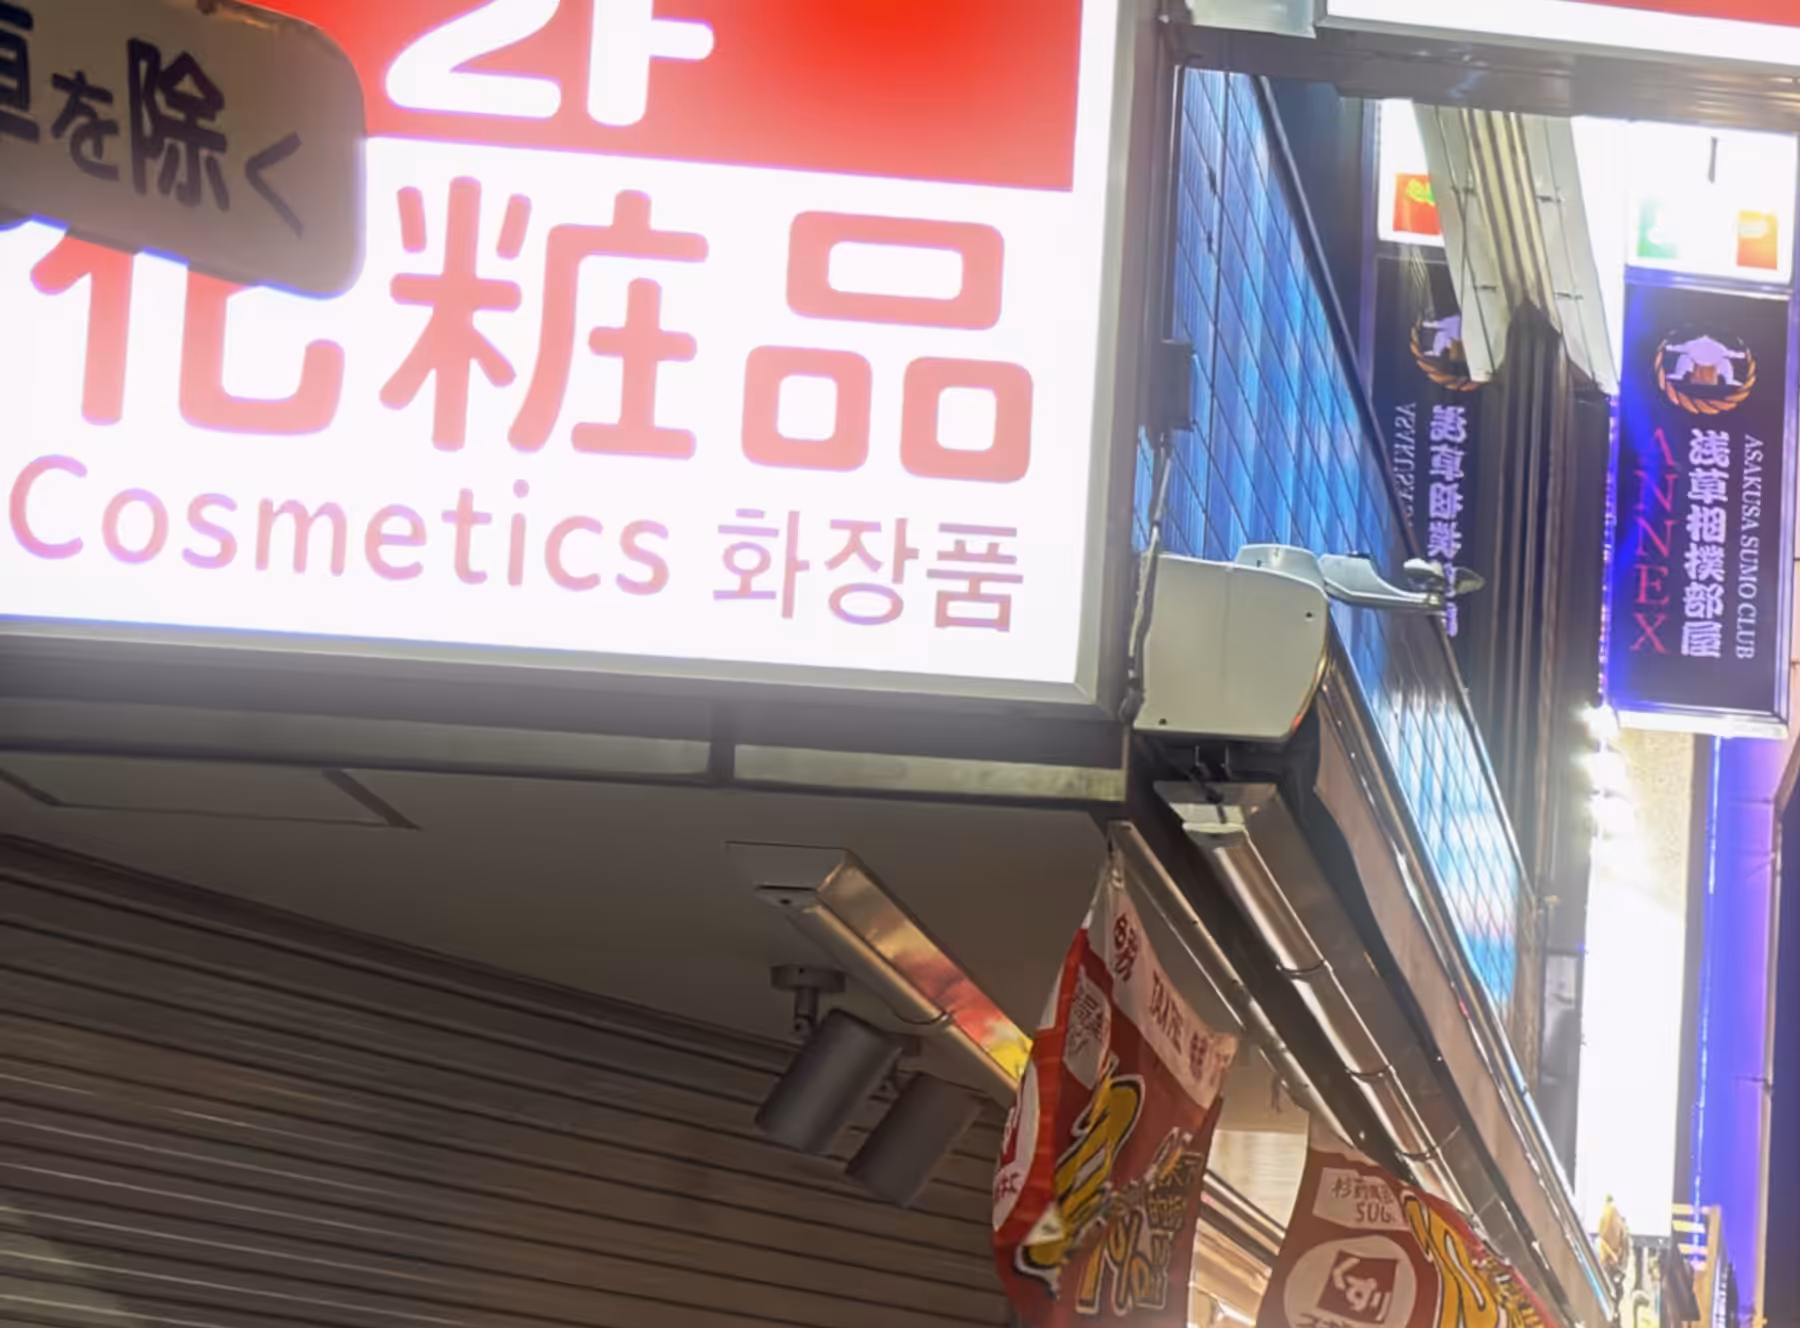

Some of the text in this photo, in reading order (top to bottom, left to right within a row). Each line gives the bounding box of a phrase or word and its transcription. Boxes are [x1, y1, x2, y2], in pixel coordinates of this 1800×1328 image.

[30, 175, 1034, 484] 化粧品
[8, 455, 670, 596] Cosmetics
[712, 506, 1025, 632] 화장품
[1629, 427, 1676, 655] ANNEX
[1681, 428, 1730, 660] 浅草相撲部屋
[1735, 434, 1765, 661] ASAKUSA SUMO CLUB
